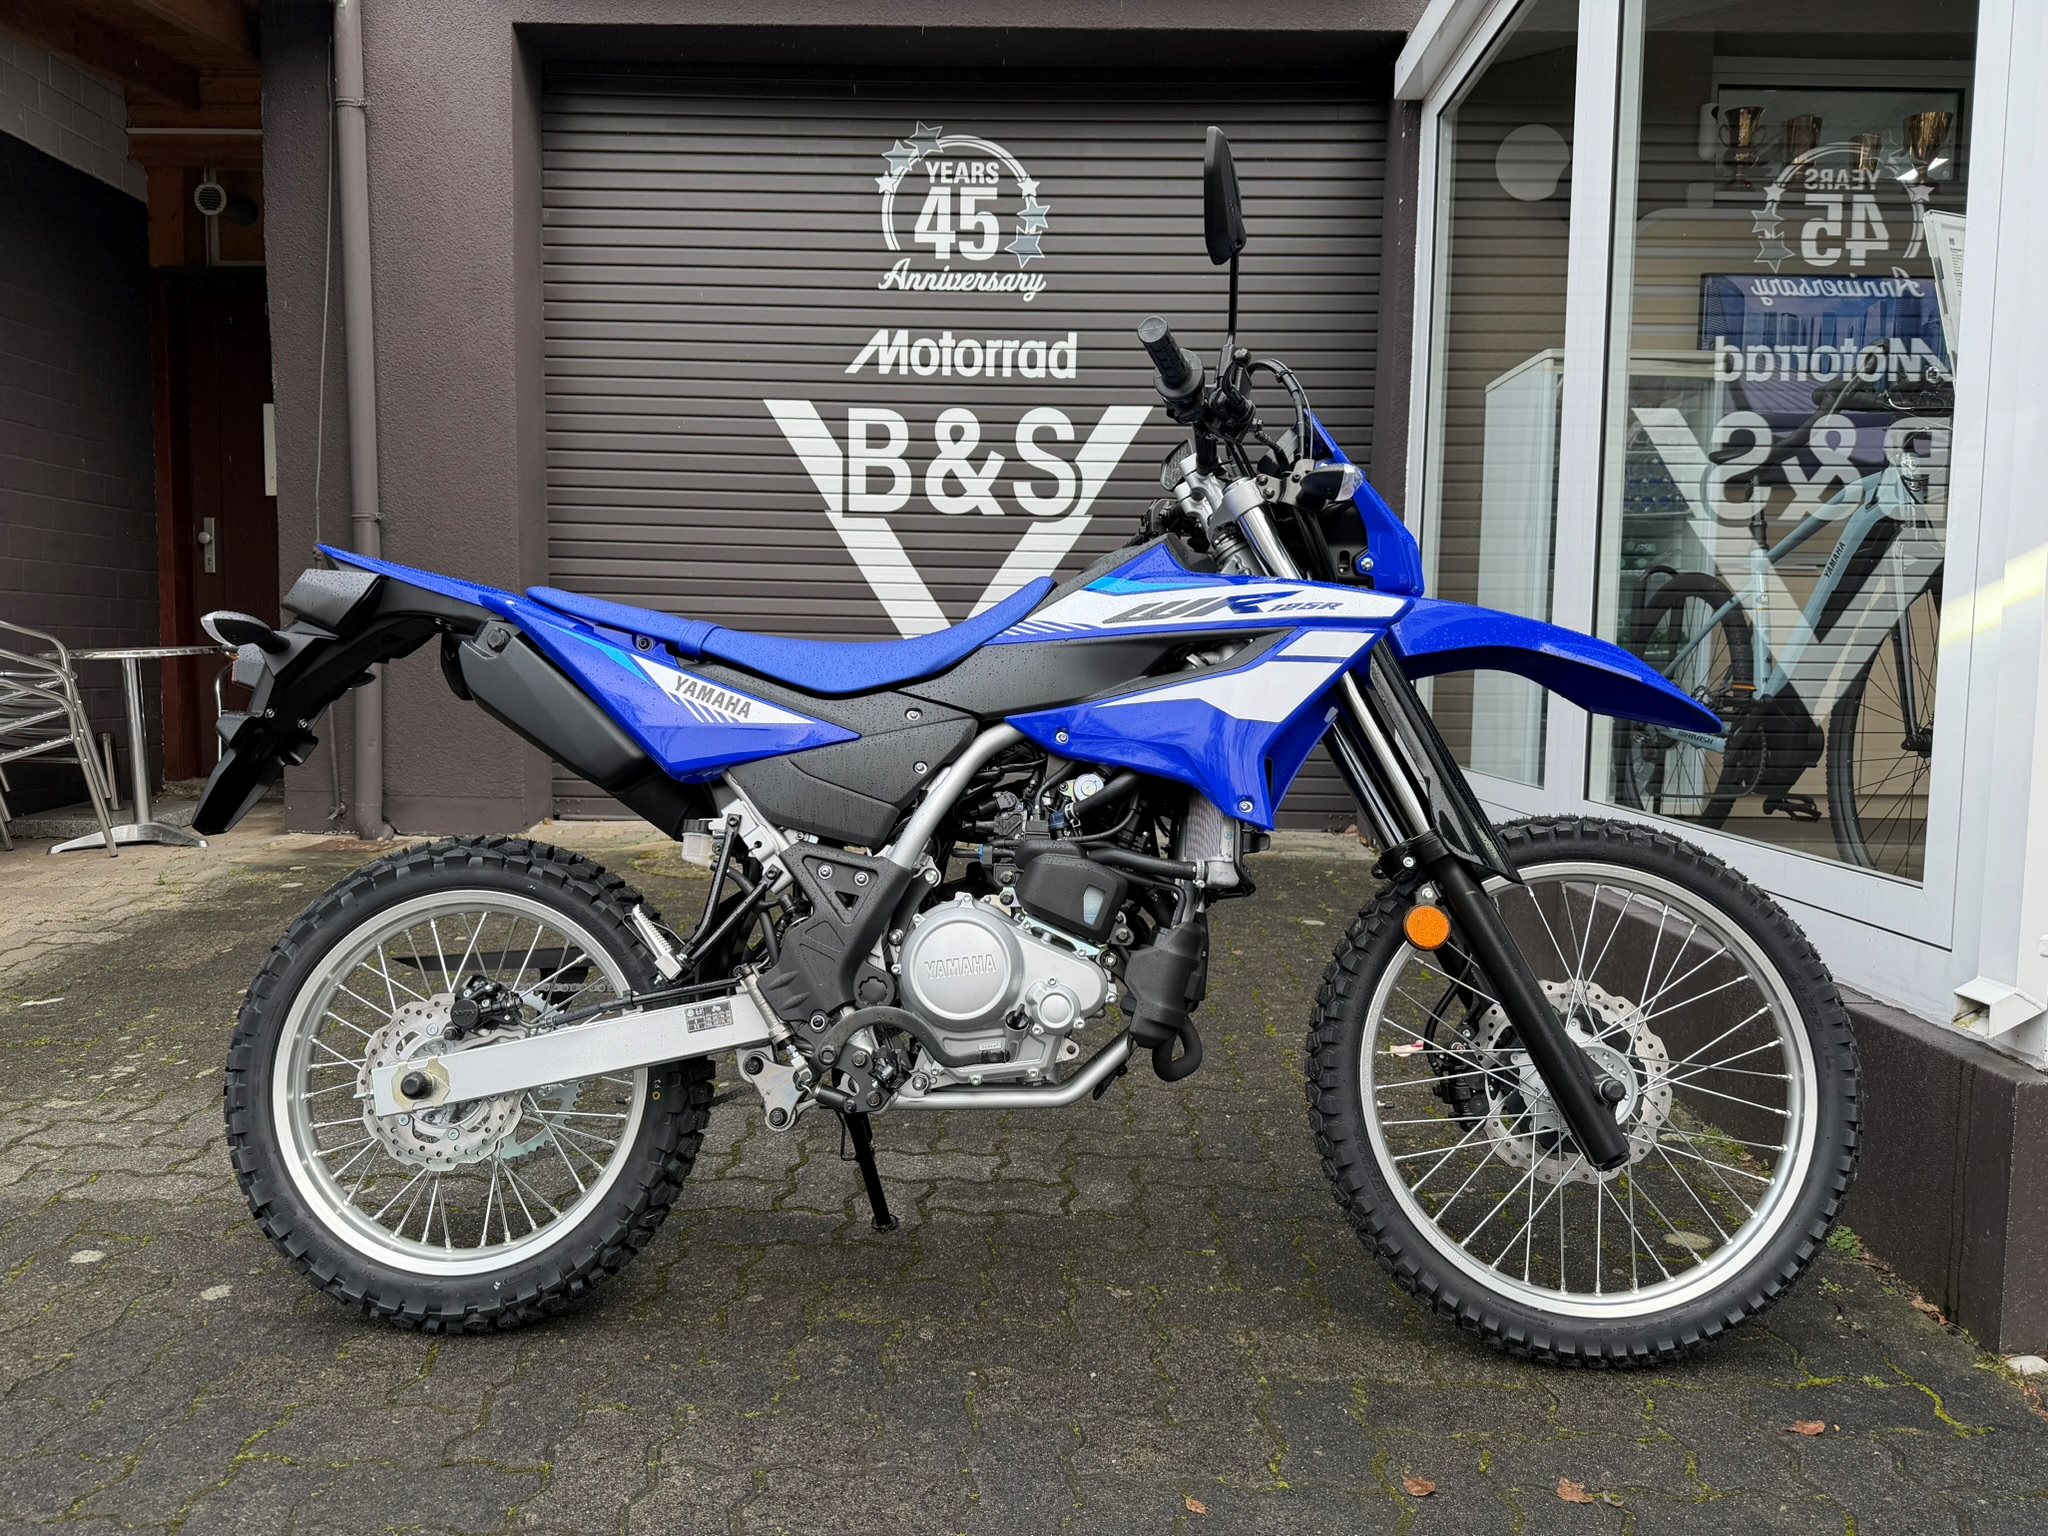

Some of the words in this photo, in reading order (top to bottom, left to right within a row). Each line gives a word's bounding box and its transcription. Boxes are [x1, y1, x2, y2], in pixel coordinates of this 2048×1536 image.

[925, 161, 999, 185] YEARS
[914, 186, 1000, 261] 45
[878, 257, 1047, 302] Anniversary
[844, 328, 1078, 379] Motorrad
[848, 406, 1077, 516] B&S
[1824, 541, 1846, 578] YAMAHA
[674, 675, 752, 720] YAMAHA
[1677, 730, 1715, 745] WABASH
[924, 954, 997, 980] YAMAHA
